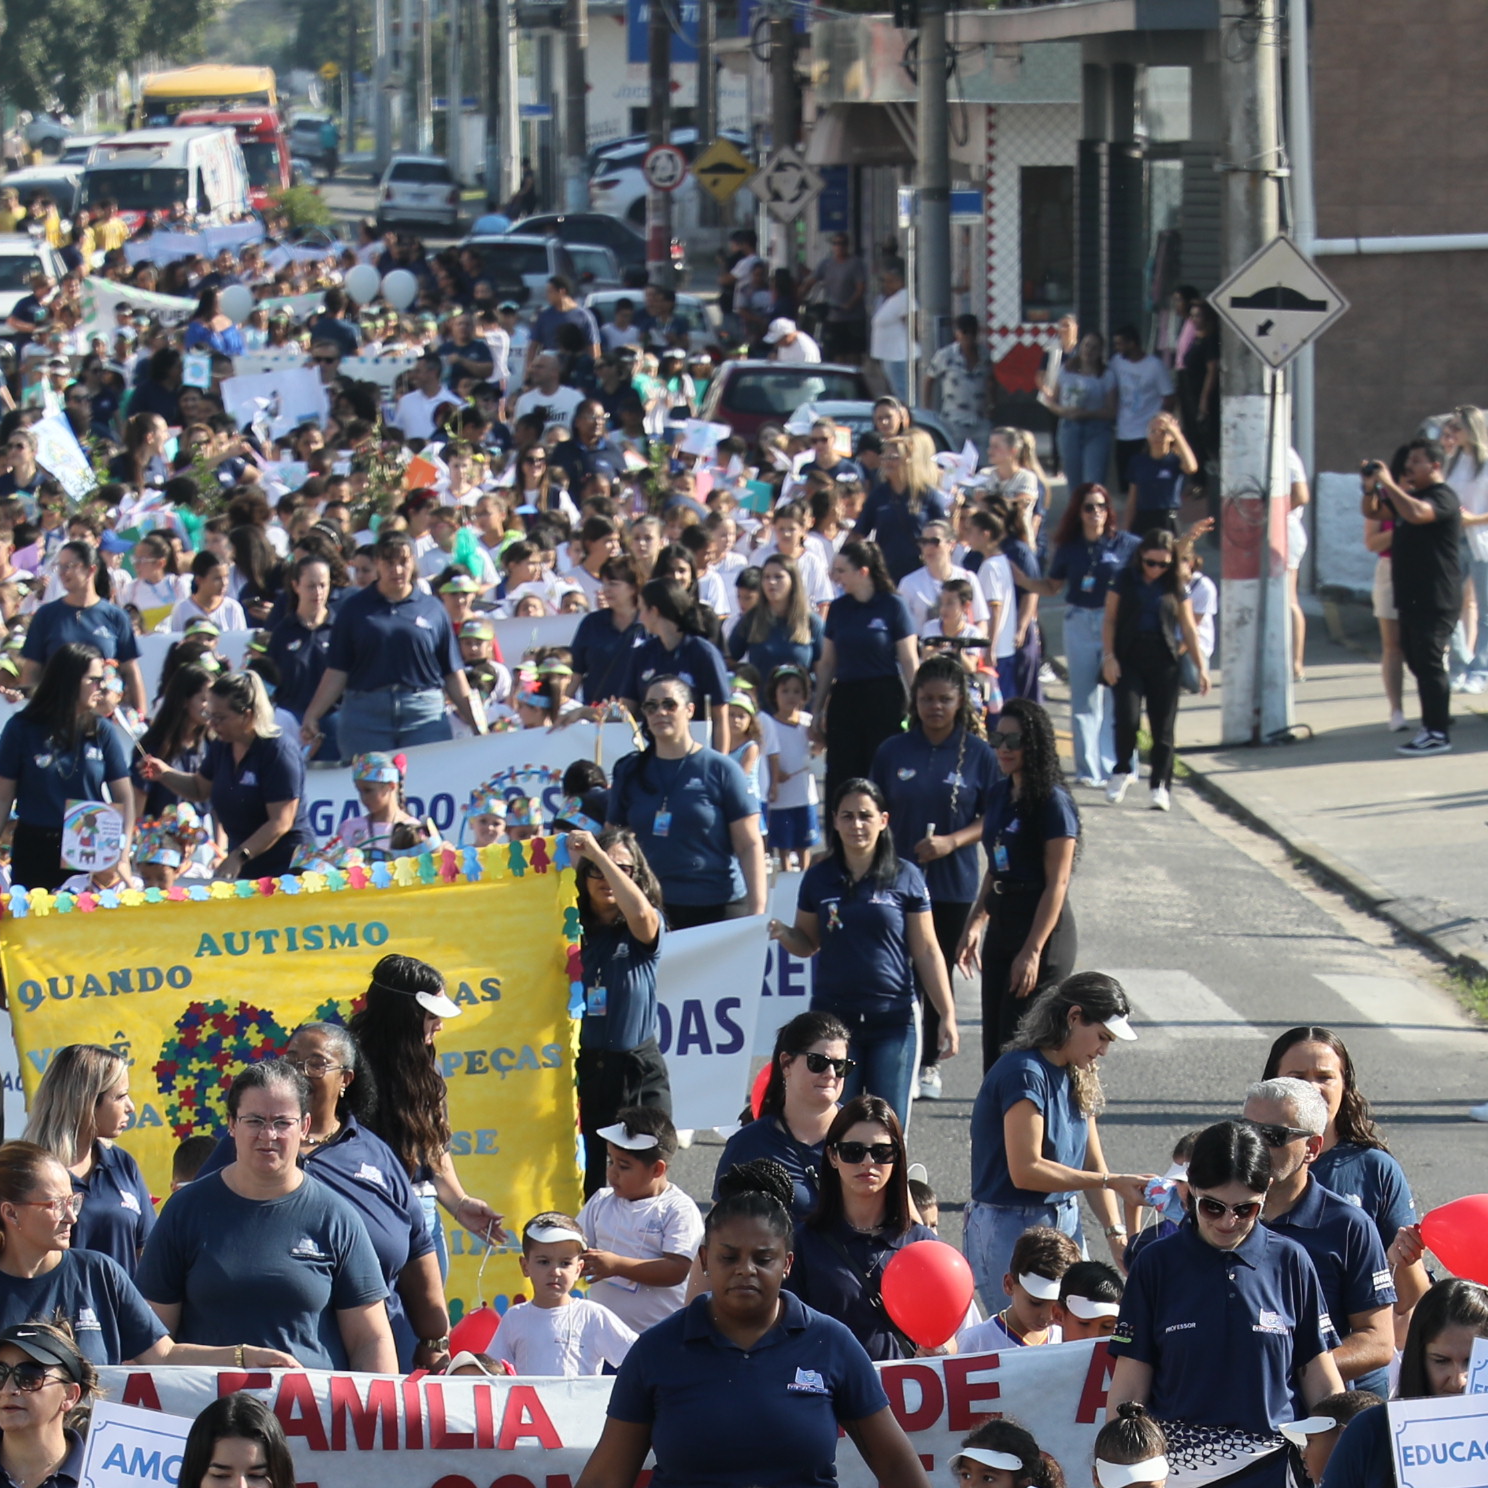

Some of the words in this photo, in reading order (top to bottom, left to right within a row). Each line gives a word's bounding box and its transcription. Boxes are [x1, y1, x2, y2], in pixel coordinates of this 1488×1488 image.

[194, 920, 390, 959] AUTISMO
[16, 965, 193, 1013] QUANDO
[1165, 1321, 1197, 1334] PROFESSOR
[101, 1442, 185, 1485] AMO
